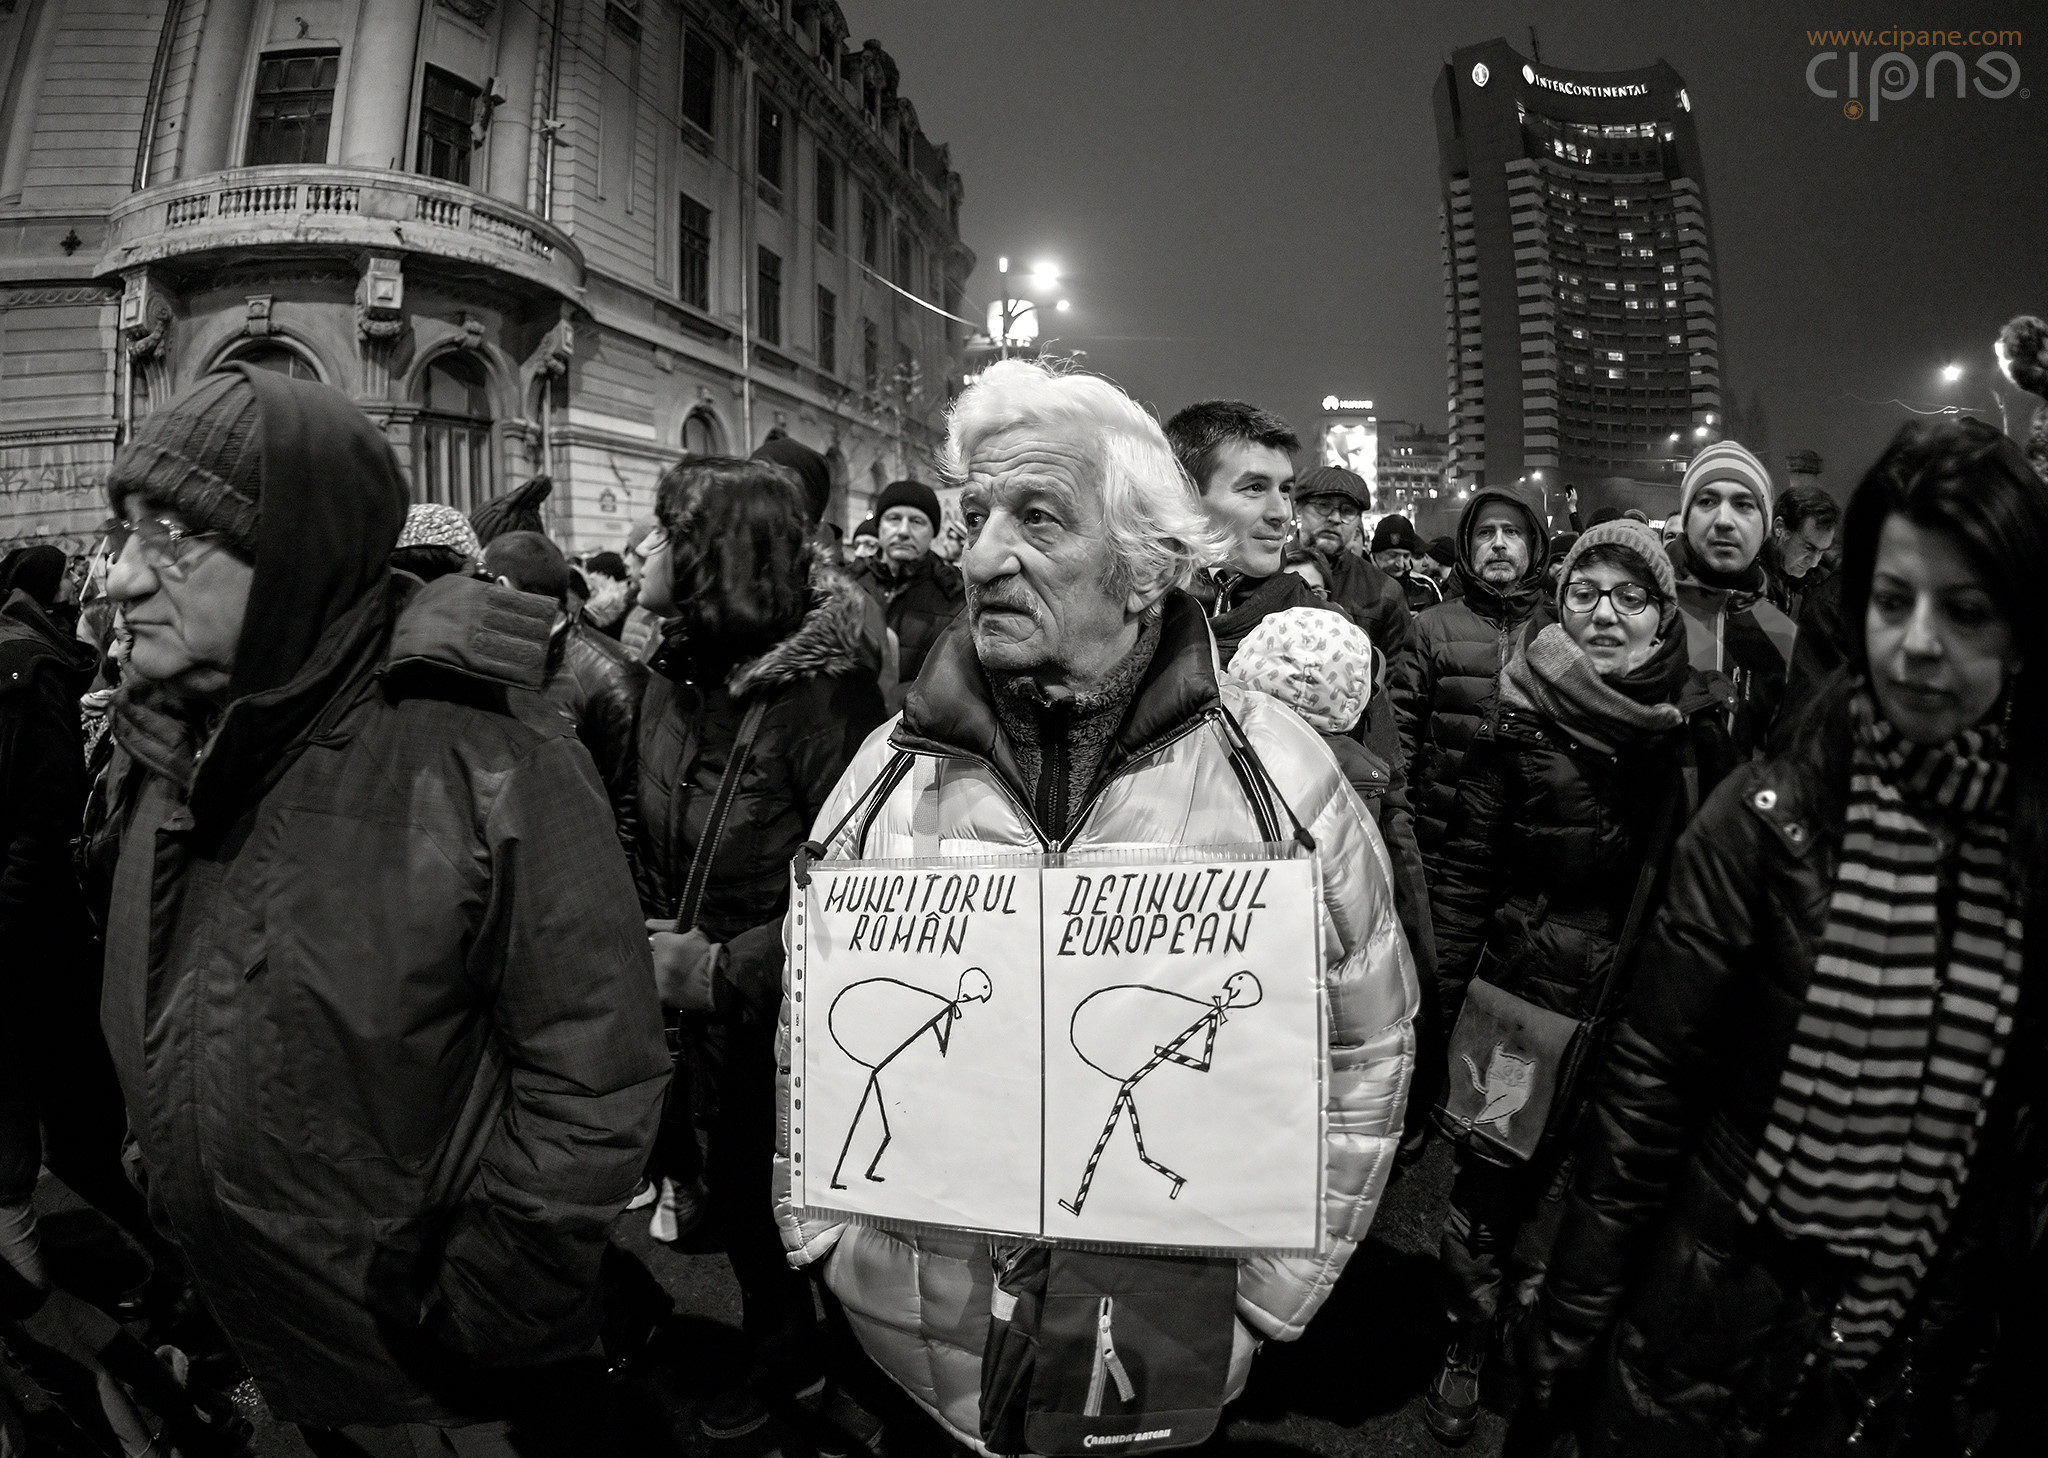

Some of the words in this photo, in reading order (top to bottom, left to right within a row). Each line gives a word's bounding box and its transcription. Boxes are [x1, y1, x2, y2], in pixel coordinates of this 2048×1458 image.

[823, 873, 1017, 914] MUNCITORUL
[1061, 867, 1270, 916] DETINUTUL
[848, 911, 969, 958] ROMÂN
[1057, 911, 1253, 957] EUROPEAN
